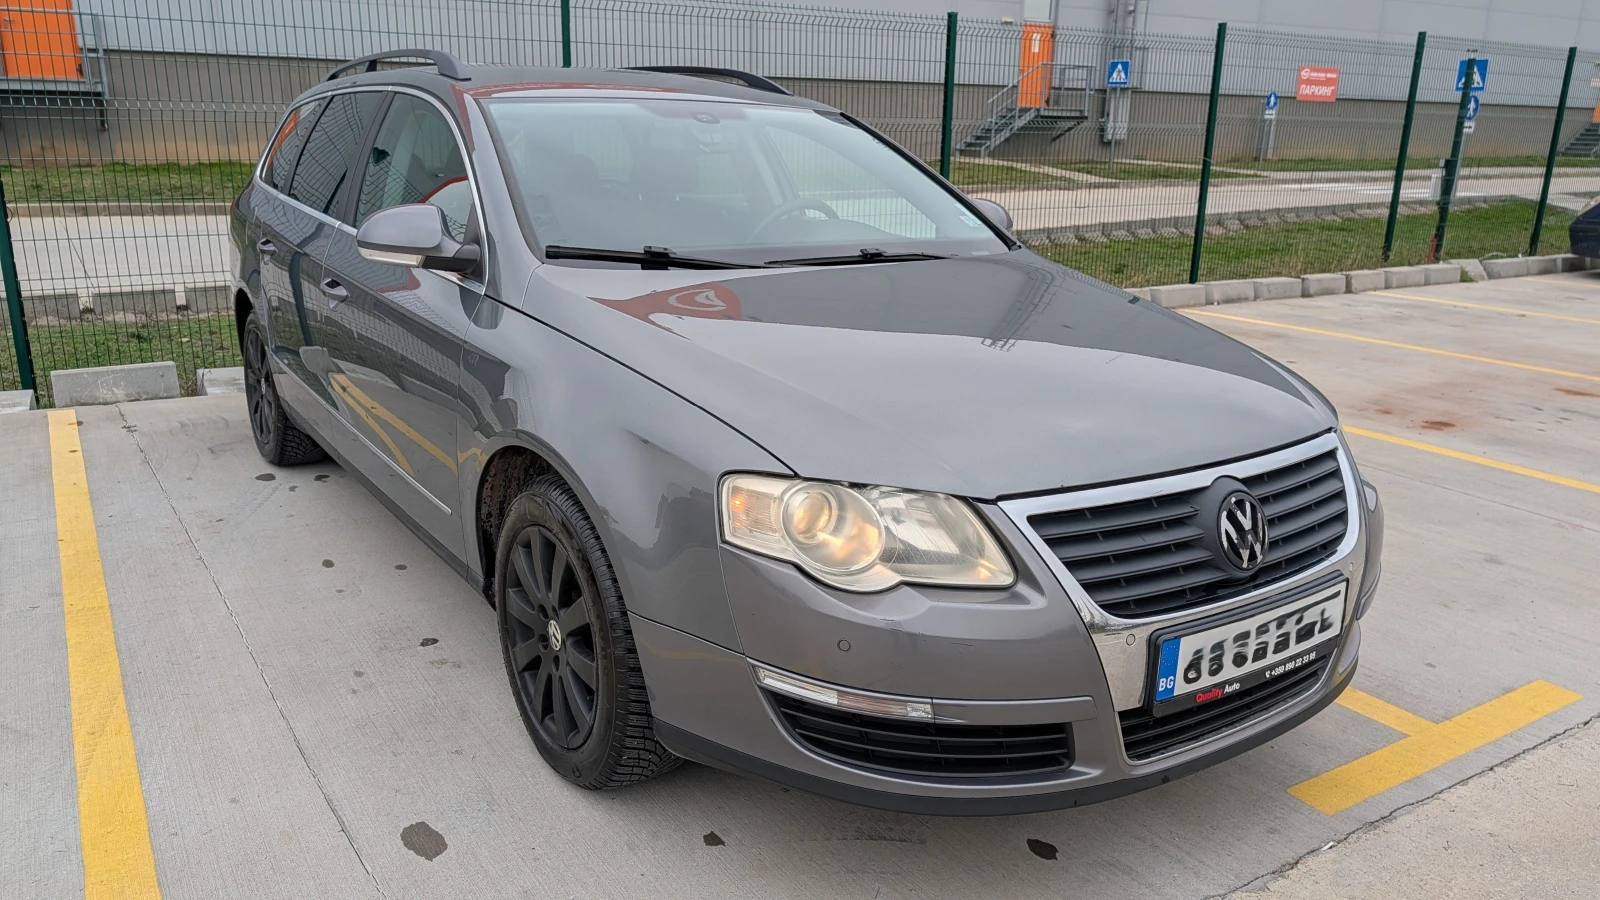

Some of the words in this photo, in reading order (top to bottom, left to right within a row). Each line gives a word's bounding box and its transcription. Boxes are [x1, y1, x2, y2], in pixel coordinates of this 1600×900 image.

[1299, 84, 1335, 96] ПАРКИНГ
[1271, 665, 1285, 676] +359
[1158, 675, 1175, 692] BG
[1196, 688, 1223, 702] Quality
[1224, 682, 1241, 694] Auto
